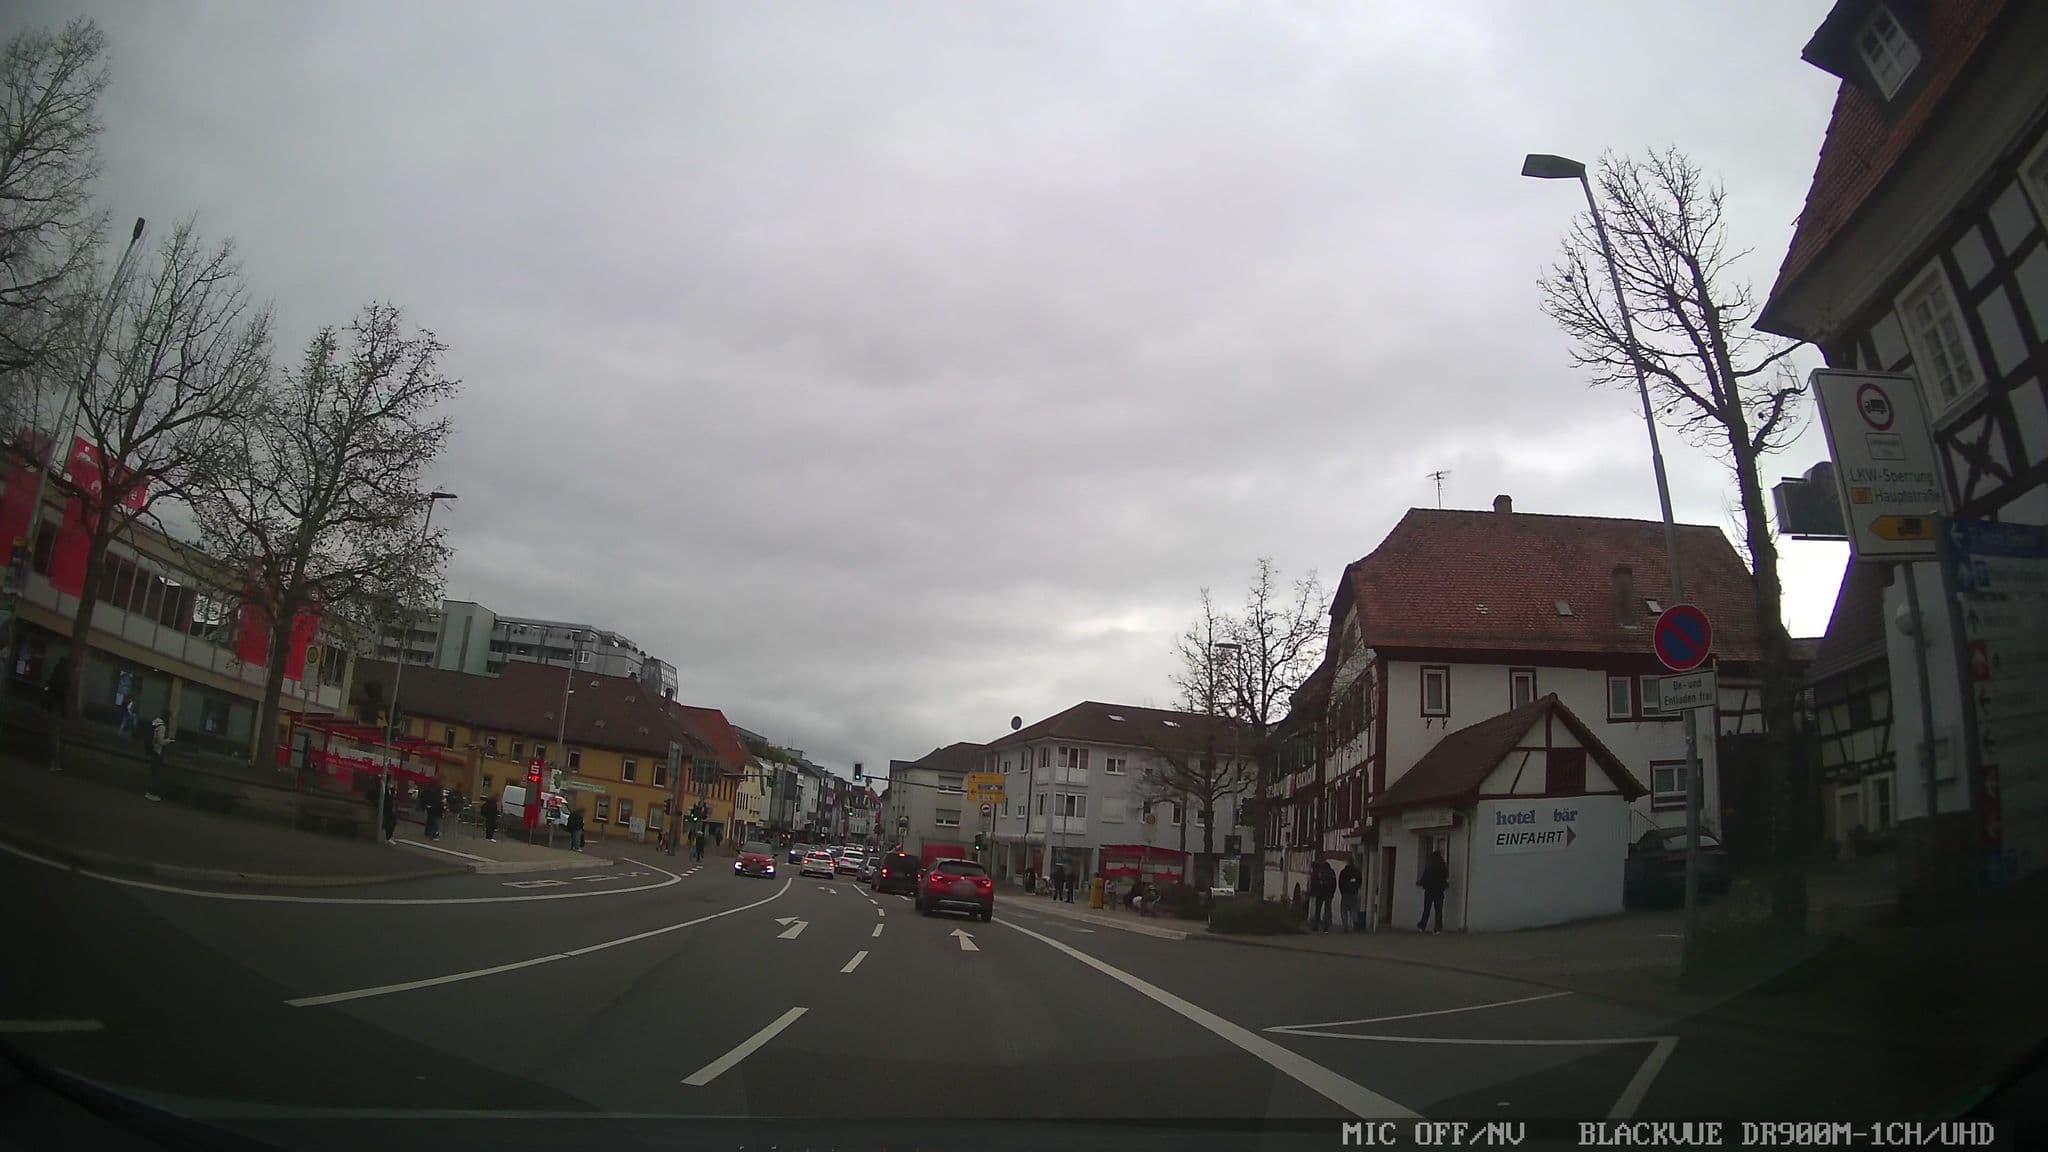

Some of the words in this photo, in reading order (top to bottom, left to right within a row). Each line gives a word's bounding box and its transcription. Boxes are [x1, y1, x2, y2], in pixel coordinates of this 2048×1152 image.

[1849, 467, 1934, 486] LKW-Sperrung
[1495, 809, 1536, 826] hotel
[1553, 808, 1578, 822] bär
[1496, 830, 1564, 846] EINFAHRT
